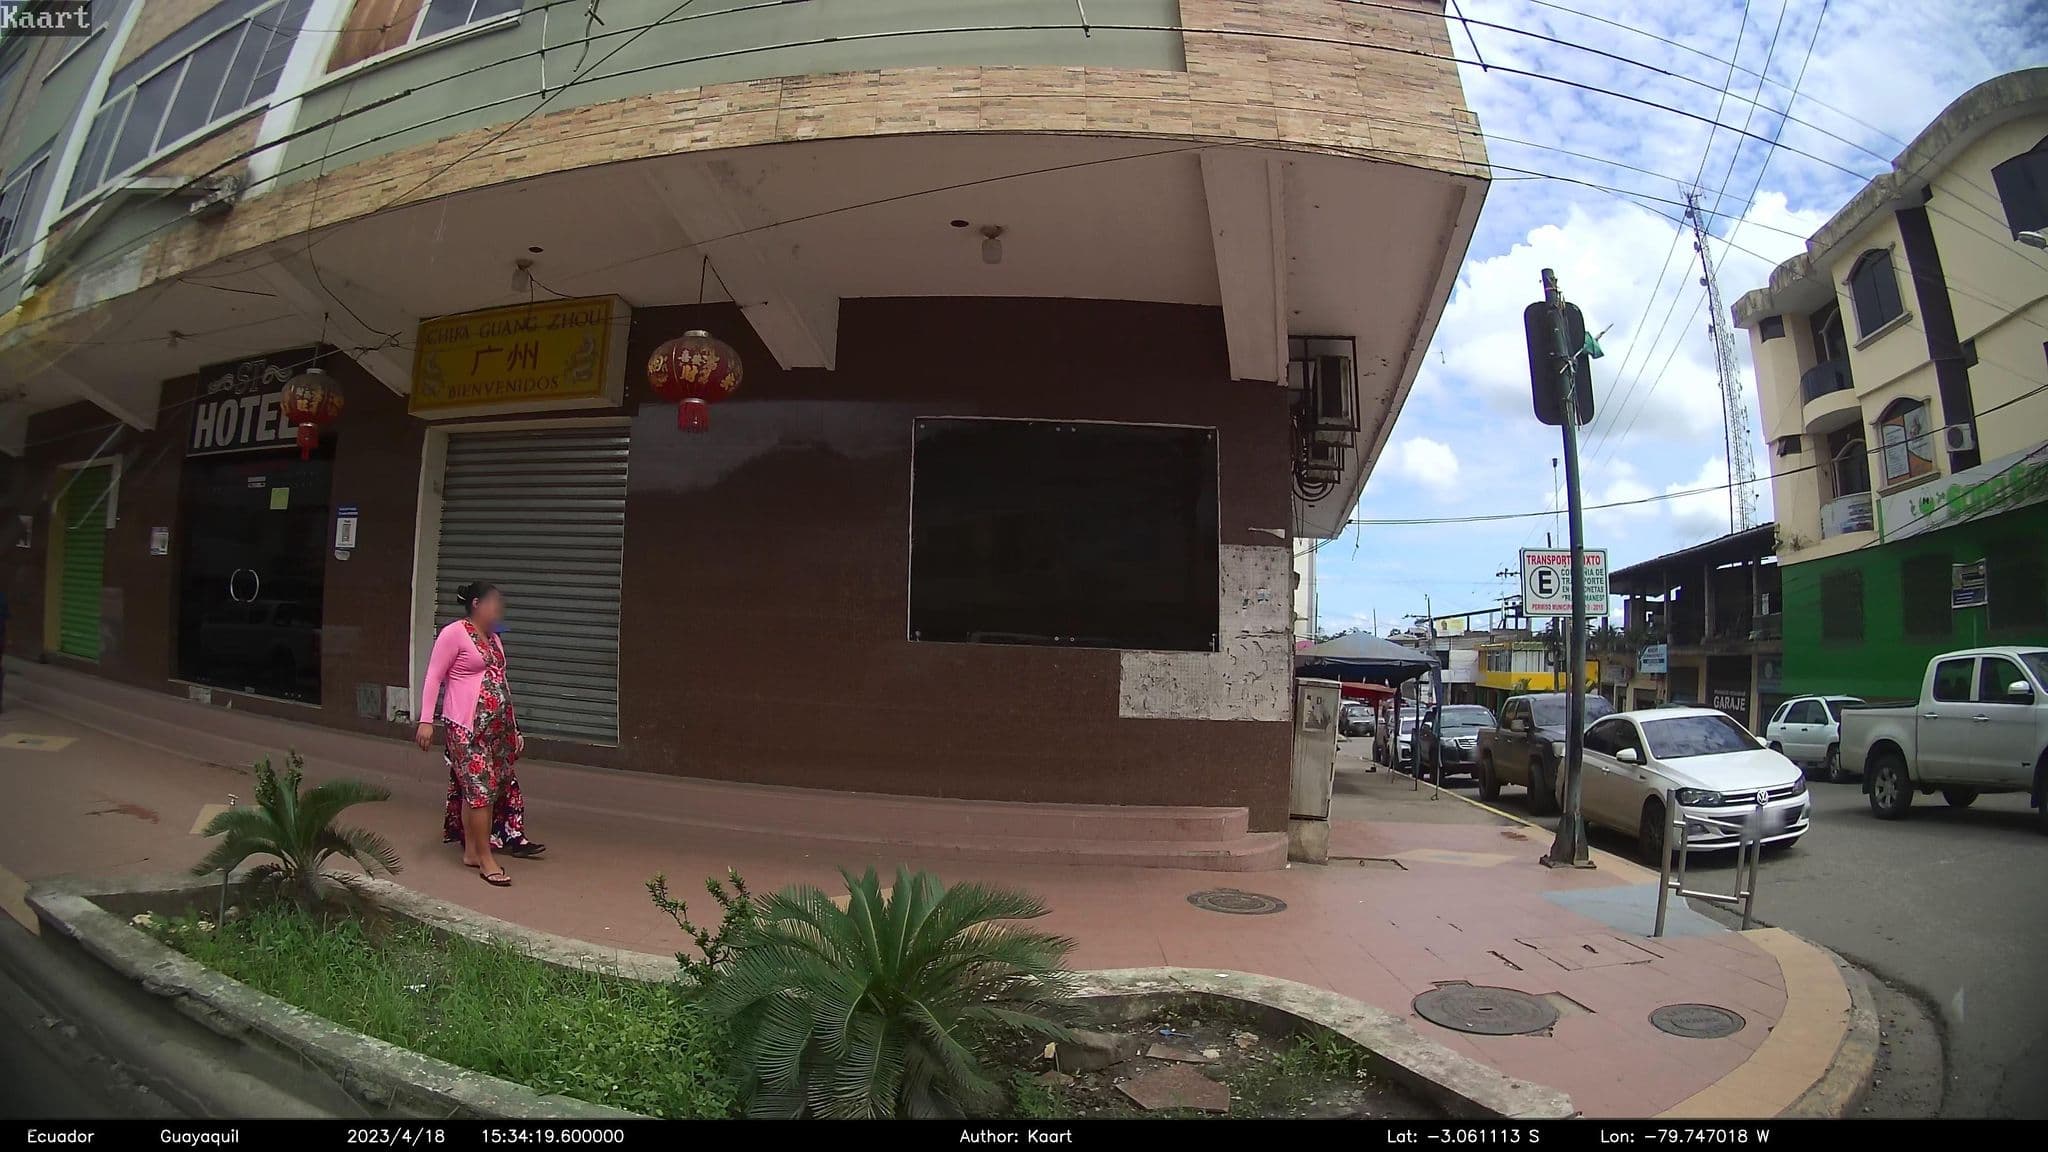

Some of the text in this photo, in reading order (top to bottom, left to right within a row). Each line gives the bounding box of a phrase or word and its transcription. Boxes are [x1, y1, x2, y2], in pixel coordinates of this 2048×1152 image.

[479, 315, 537, 338] GUANG
[547, 308, 602, 330] ZHOU
[470, 339, 540, 376] 广州
[448, 375, 560, 399] BIENVENIDOS
[193, 392, 299, 449] HOTEL
[1526, 555, 1571, 565] TRANSPORT
[1595, 568, 1604, 576] DE
[1538, 570, 1553, 594] E
[1713, 695, 1746, 711] GARAJE
